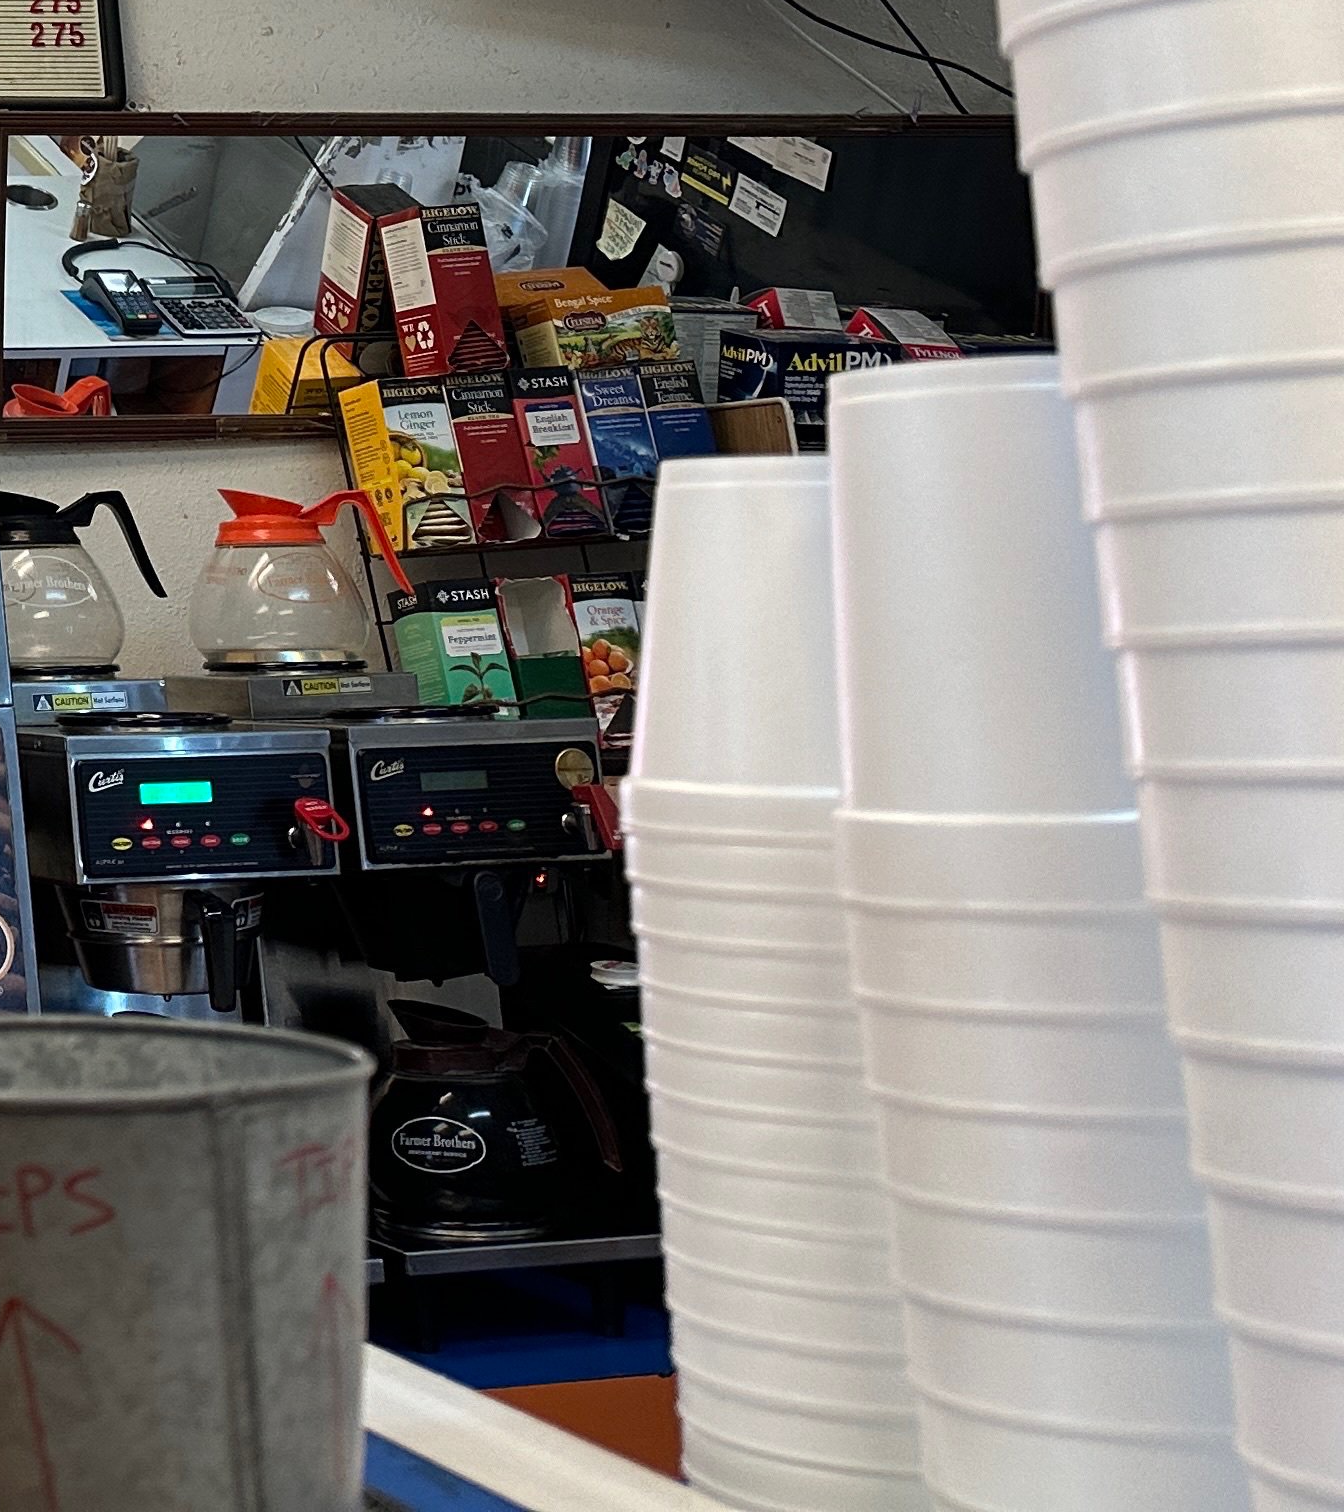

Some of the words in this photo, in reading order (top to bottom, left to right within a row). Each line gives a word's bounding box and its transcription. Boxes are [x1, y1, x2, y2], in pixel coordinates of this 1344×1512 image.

[427, 220, 479, 235] Cinnamon
[530, 376, 568, 389] STASH
[383, 386, 441, 398] BIGELOW
[398, 409, 433, 420] Lemon
[399, 420, 436, 432] Ginger
[450, 588, 490, 601] STASH
[587, 604, 625, 617] Orange
